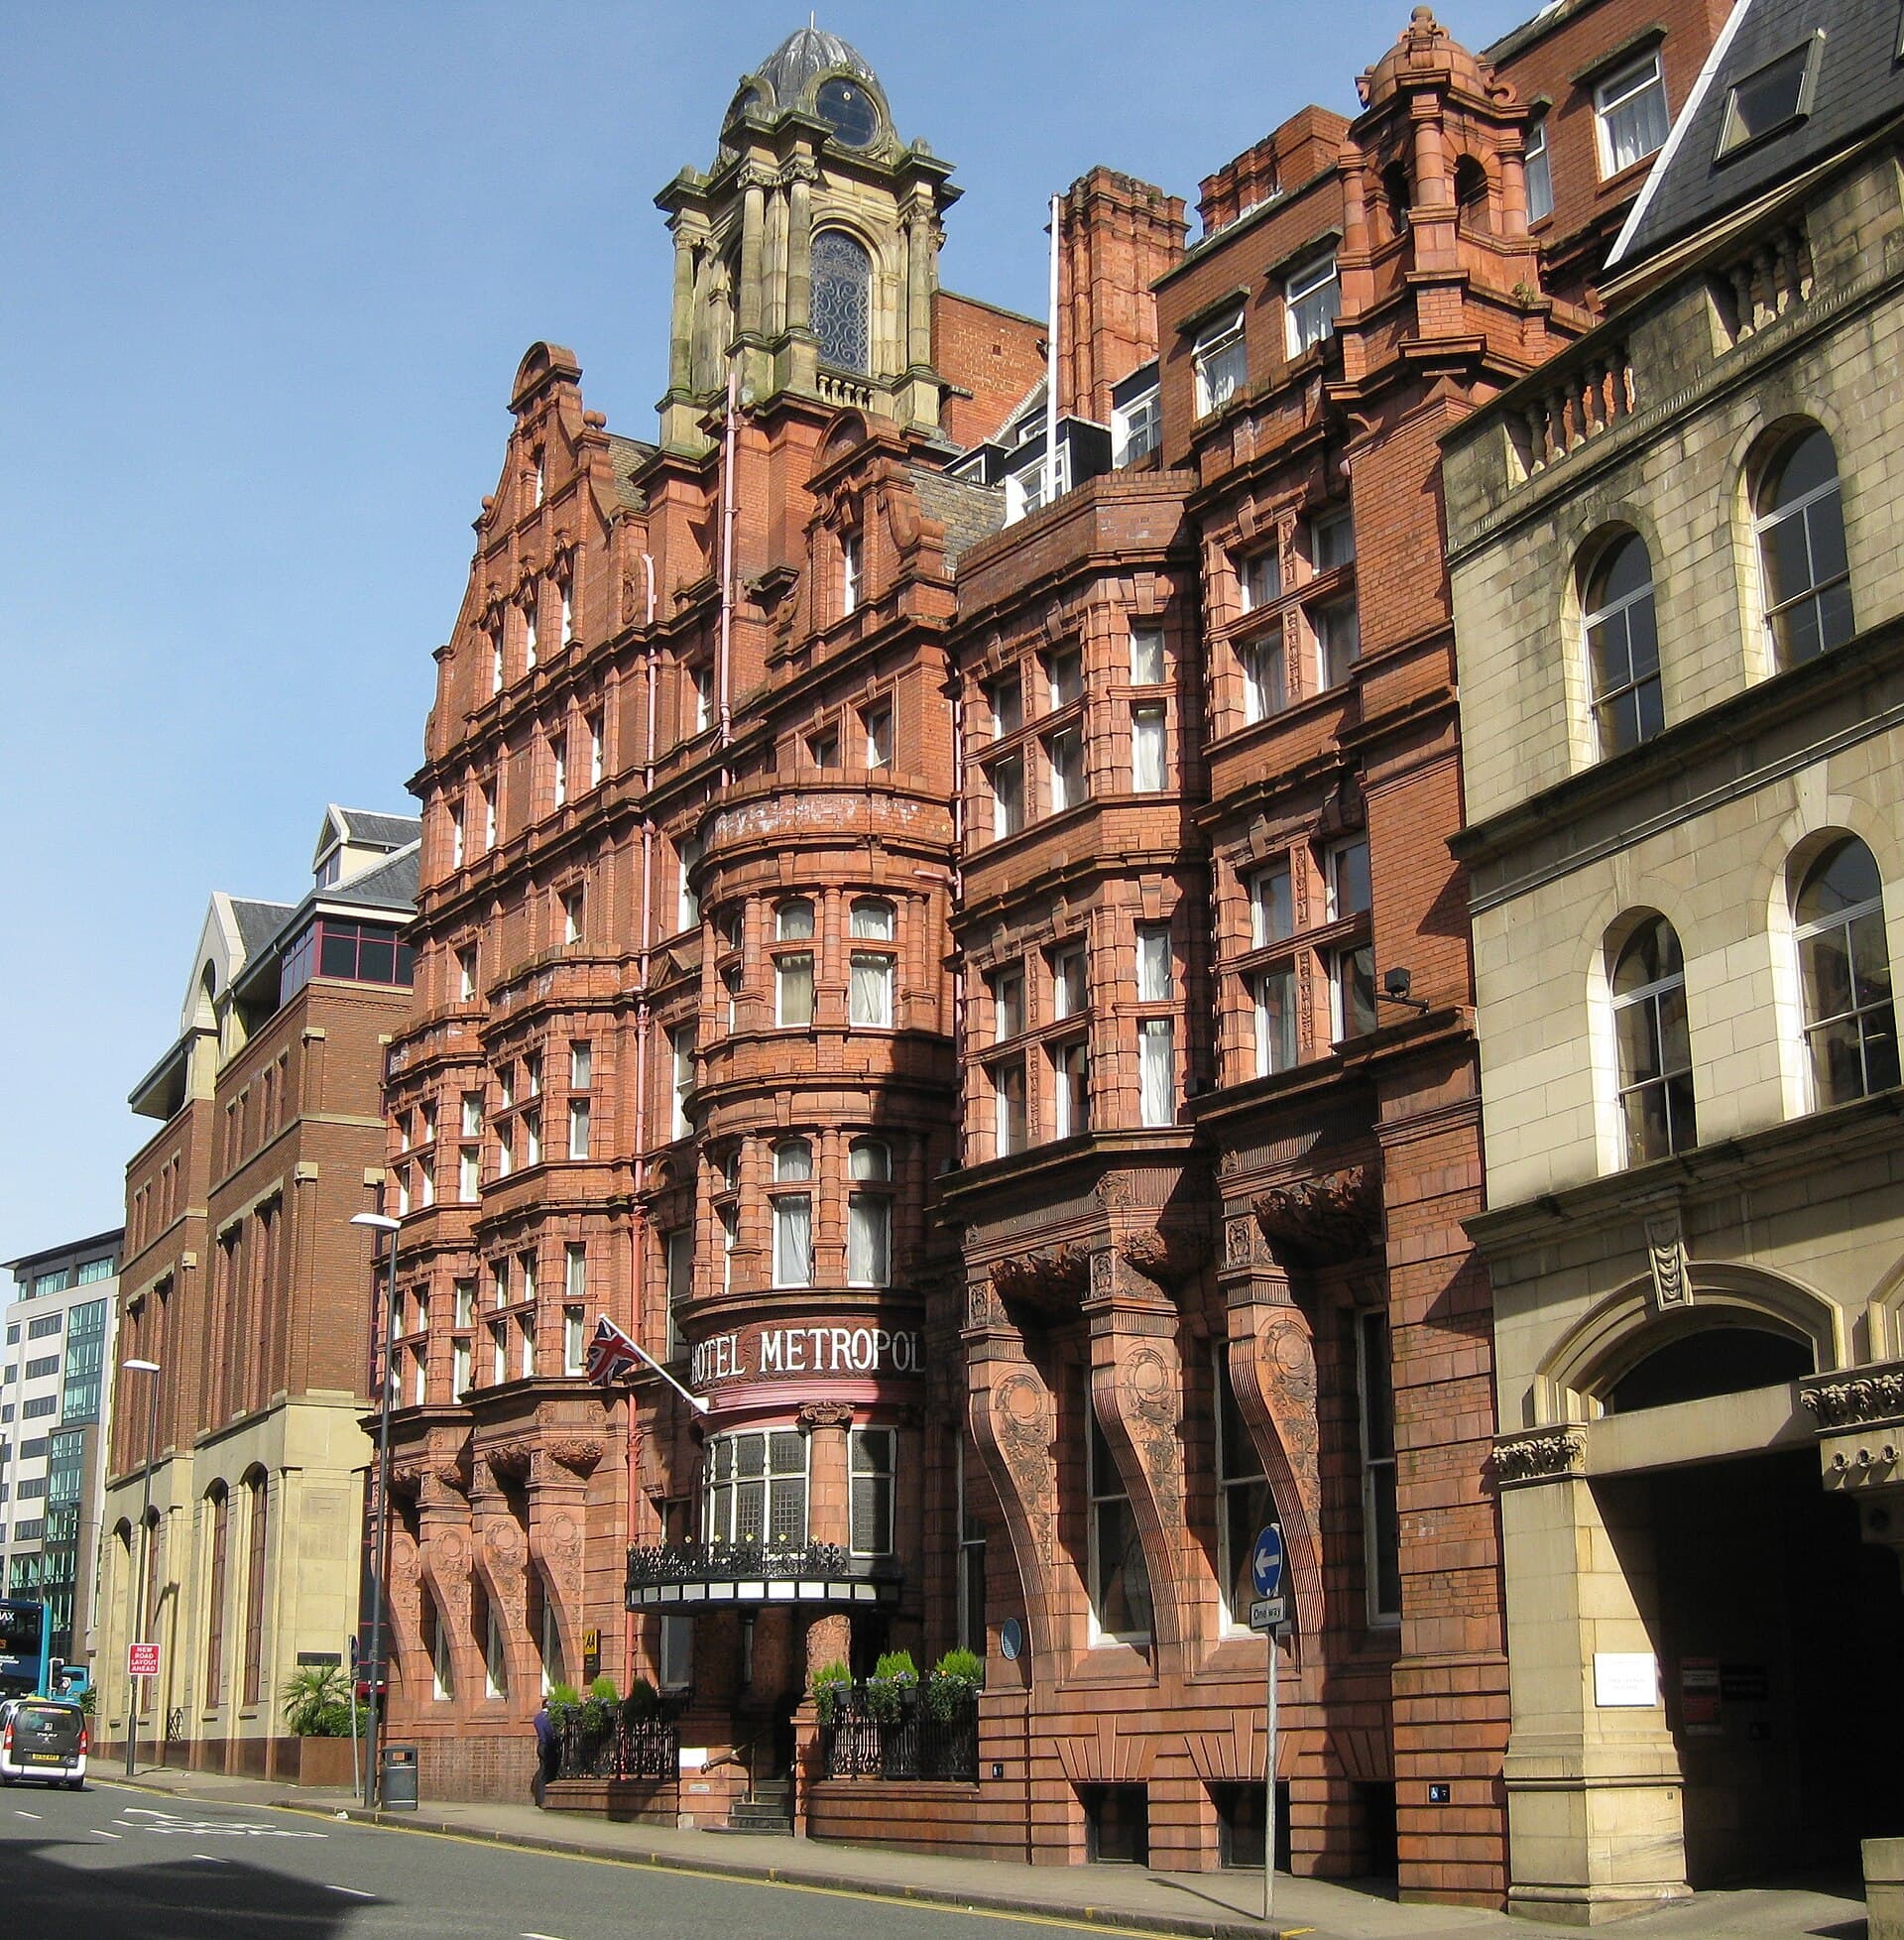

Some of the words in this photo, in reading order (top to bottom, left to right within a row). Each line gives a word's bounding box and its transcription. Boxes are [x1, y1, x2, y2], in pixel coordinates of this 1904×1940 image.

[690, 1334, 747, 1387] HOTEL
[759, 1327, 926, 1374] METROPOL
[1253, 1609, 1267, 1621] One
[1268, 1608, 1281, 1619] way
[586, 1635, 595, 1648] AA
